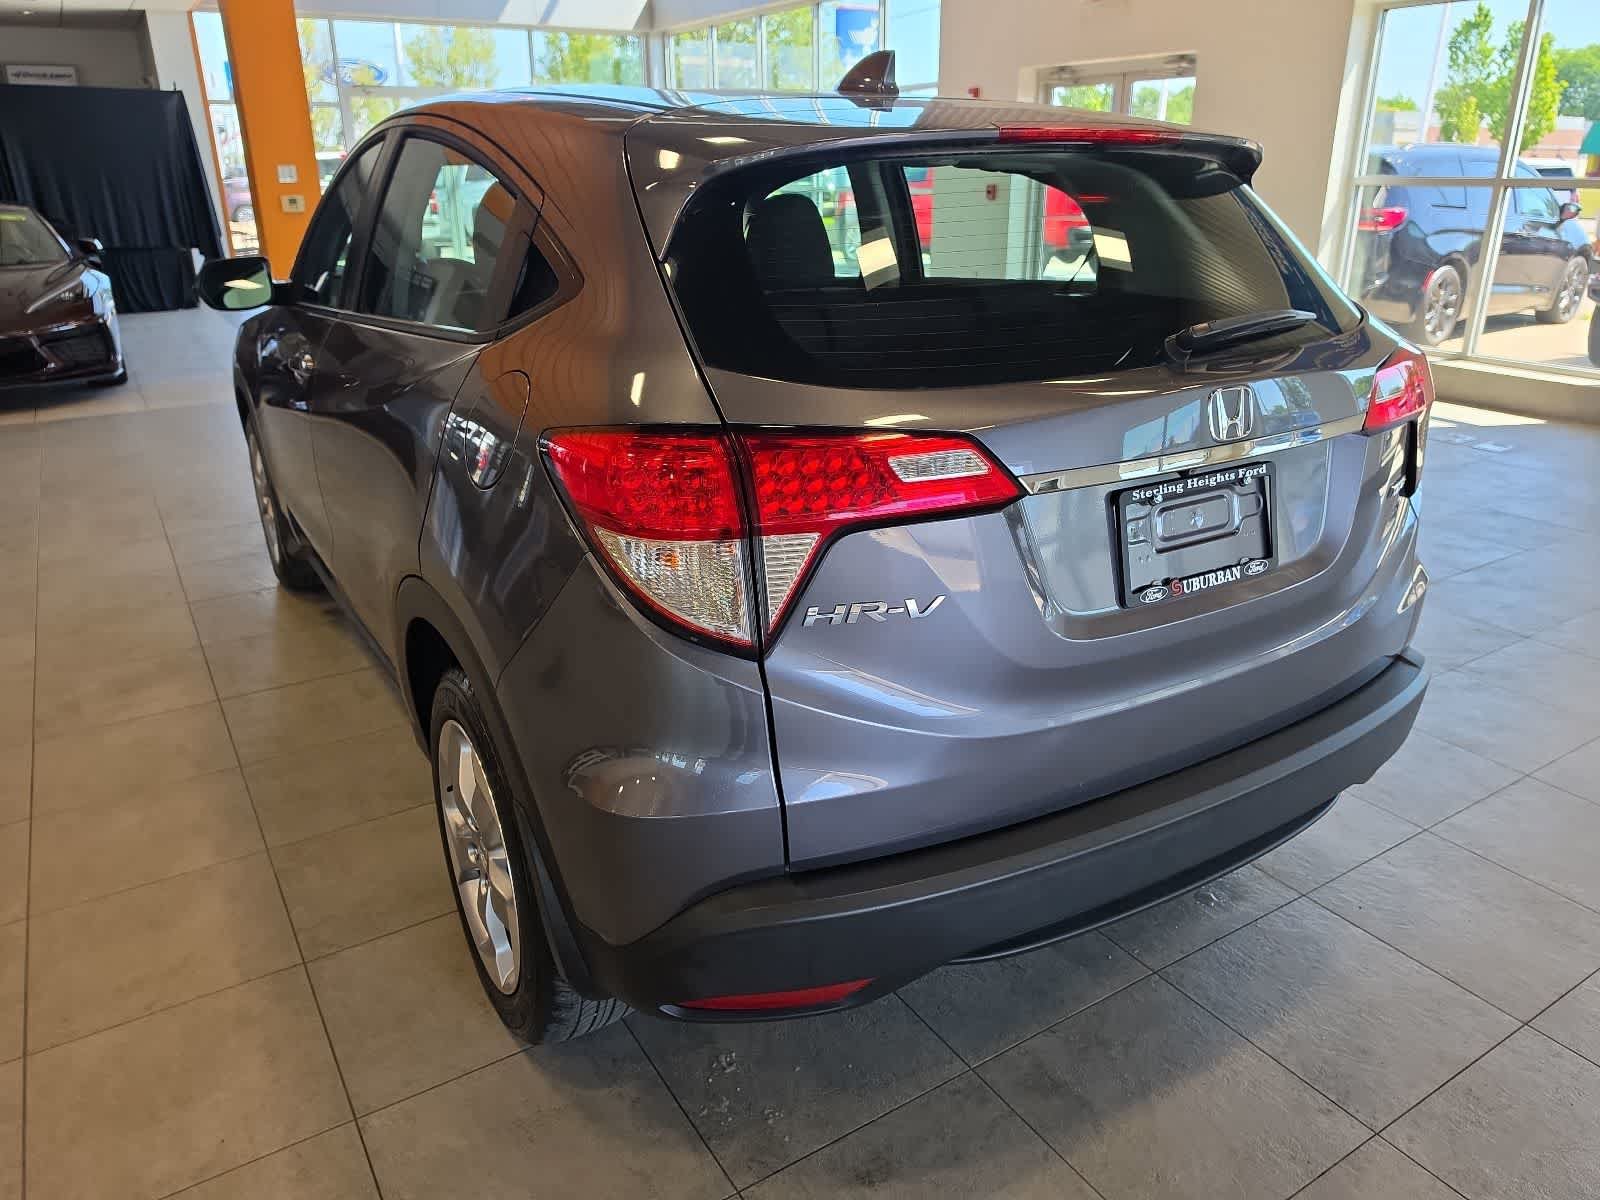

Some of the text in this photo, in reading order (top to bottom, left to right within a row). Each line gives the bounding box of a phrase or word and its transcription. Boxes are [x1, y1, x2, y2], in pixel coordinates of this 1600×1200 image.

[1132, 464, 1267, 501] Sterling Heights Ford
[1171, 566, 1242, 597] SUBURBAN
[1247, 560, 1267, 575] Ford
[1143, 587, 1166, 601] Ford
[802, 595, 947, 627] HR-V
